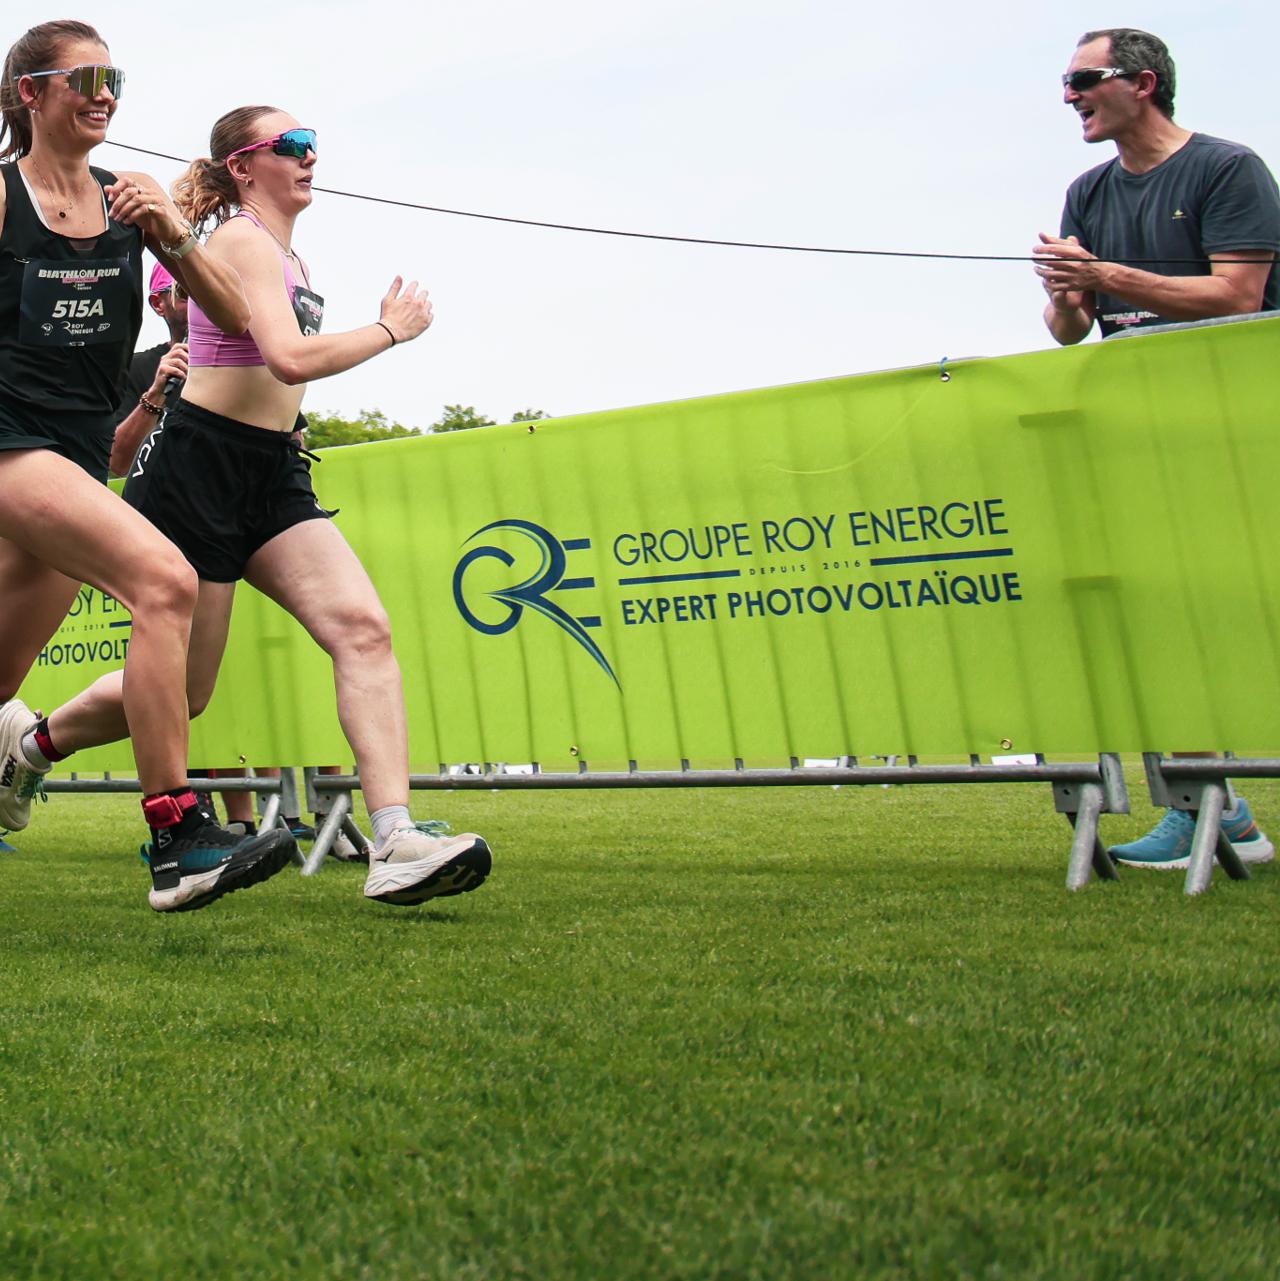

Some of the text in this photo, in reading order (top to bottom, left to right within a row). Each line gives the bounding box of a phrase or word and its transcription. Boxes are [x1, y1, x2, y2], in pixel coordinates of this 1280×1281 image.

[38, 267, 121, 279] BIATHLON RUN
[51, 298, 105, 319] 515A
[613, 498, 1009, 566] GROUPE ROY ENERGIE
[749, 560, 862, 576] DEPUIS 2016
[621, 569, 1023, 625] EXPERT PHOTOVOLTAÏQUE
[37, 638, 130, 667] HOTOVOLT
[0, 754, 17, 787] HOKA
